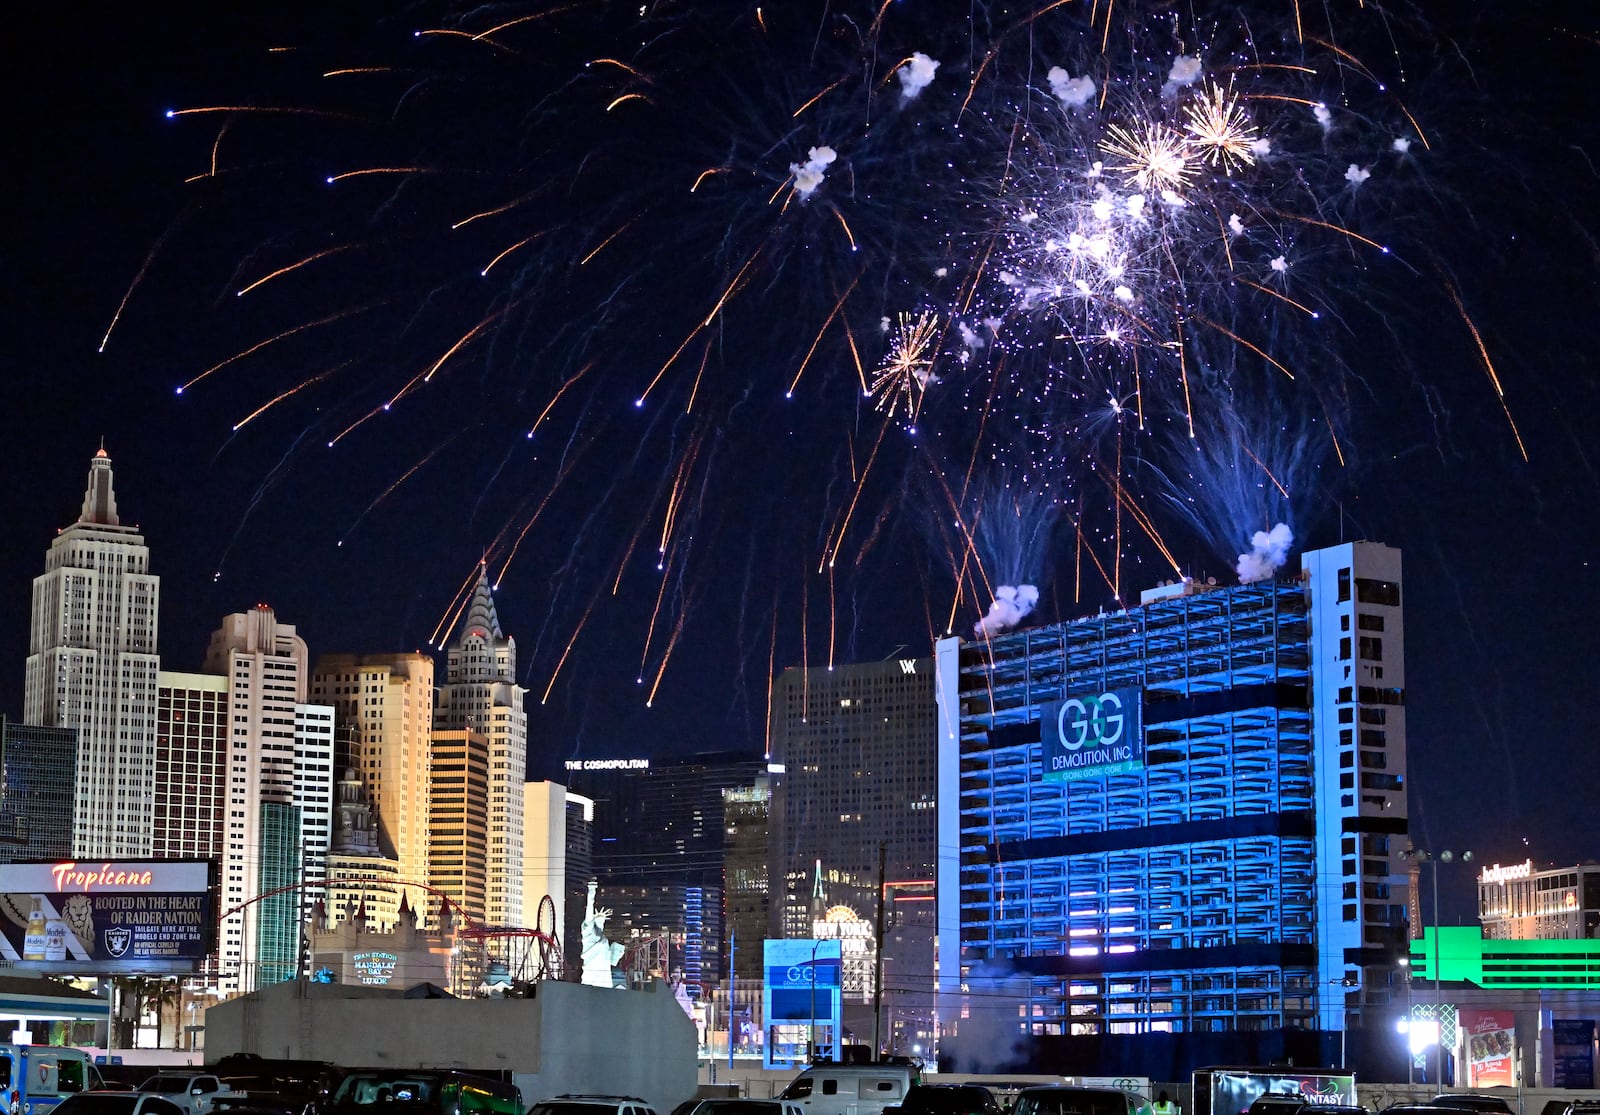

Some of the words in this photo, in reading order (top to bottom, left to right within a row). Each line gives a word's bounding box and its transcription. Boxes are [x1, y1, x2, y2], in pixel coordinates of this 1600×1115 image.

[564, 760, 582, 770] THE
[583, 759, 650, 770] COSMOPOLITAN
[1052, 750, 1112, 770] DEMOLITION,
[1113, 746, 1134, 761] INC.
[51, 862, 153, 893] Tropicana
[1482, 858, 1531, 886] hollywood
[95, 897, 135, 909] ROOTED
[136, 897, 147, 909] IN
[148, 897, 167, 909] THE
[168, 896, 202, 909] HEART
[111, 911, 126, 924] OF
[126, 911, 162, 924] RAIDER
[164, 911, 202, 924] NATION
[134, 925, 160, 933] TAILGATE
[161, 925, 177, 933] HERE
[178, 925, 186, 933] AT
[187, 925, 197, 933] THE
[812, 922, 838, 936] NEW
[840, 922, 869, 936] YORK
[1301, 1093, 1345, 1106] ANTASY
